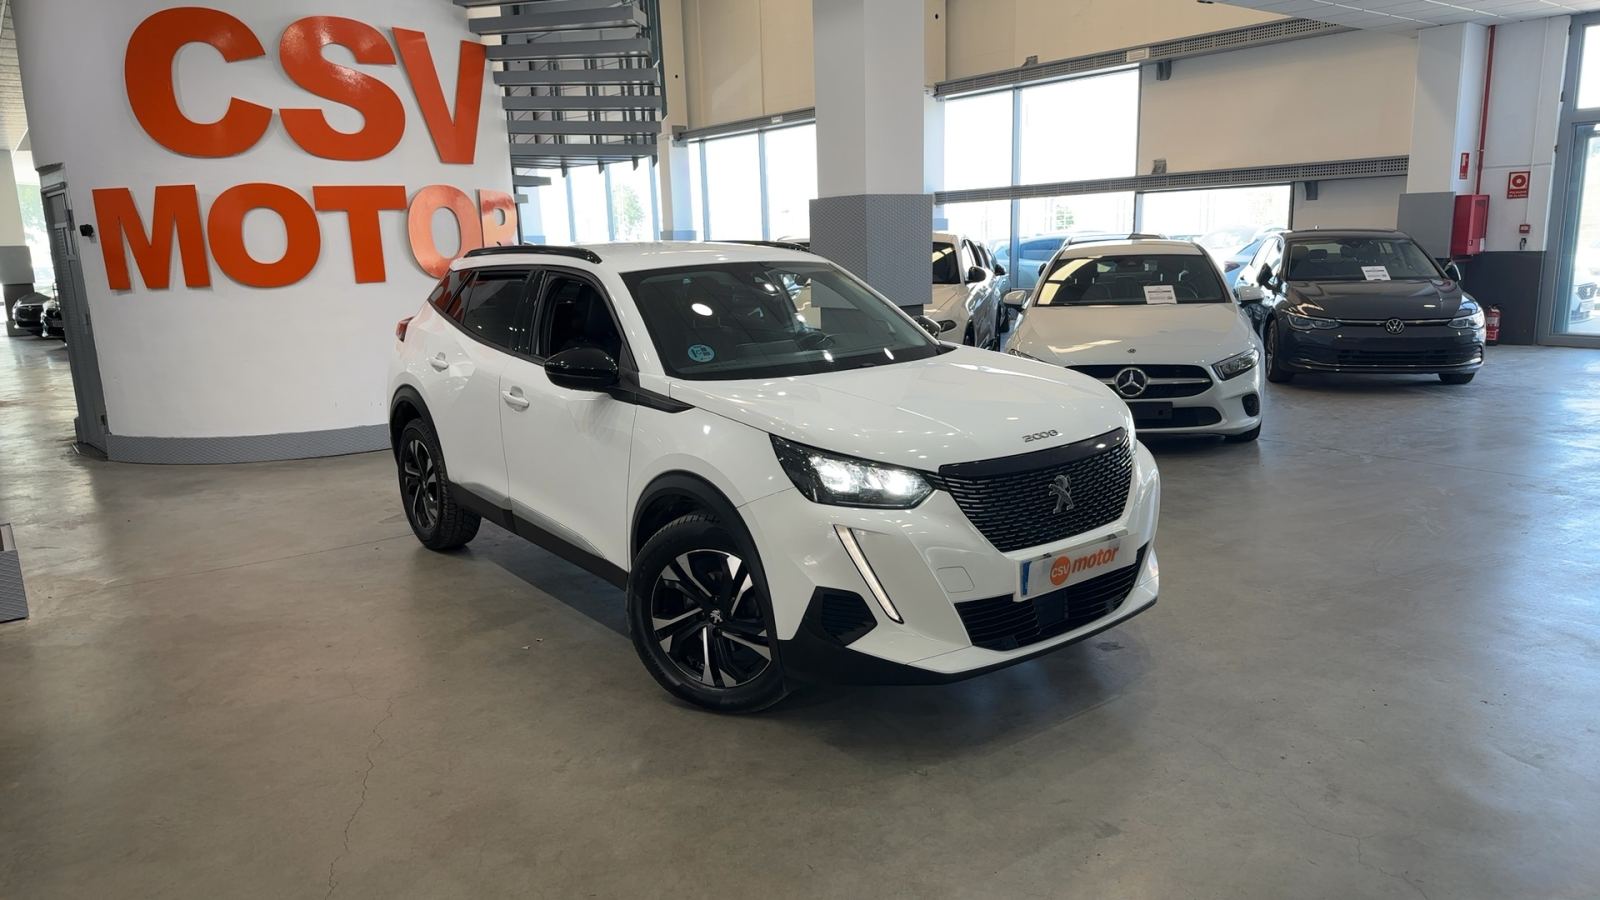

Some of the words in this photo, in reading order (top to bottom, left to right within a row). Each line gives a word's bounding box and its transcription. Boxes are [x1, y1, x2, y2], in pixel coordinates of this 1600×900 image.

[125, 6, 487, 165] CSV
[92, 183, 518, 290] MOTOR
[1071, 547, 1120, 573] motor
